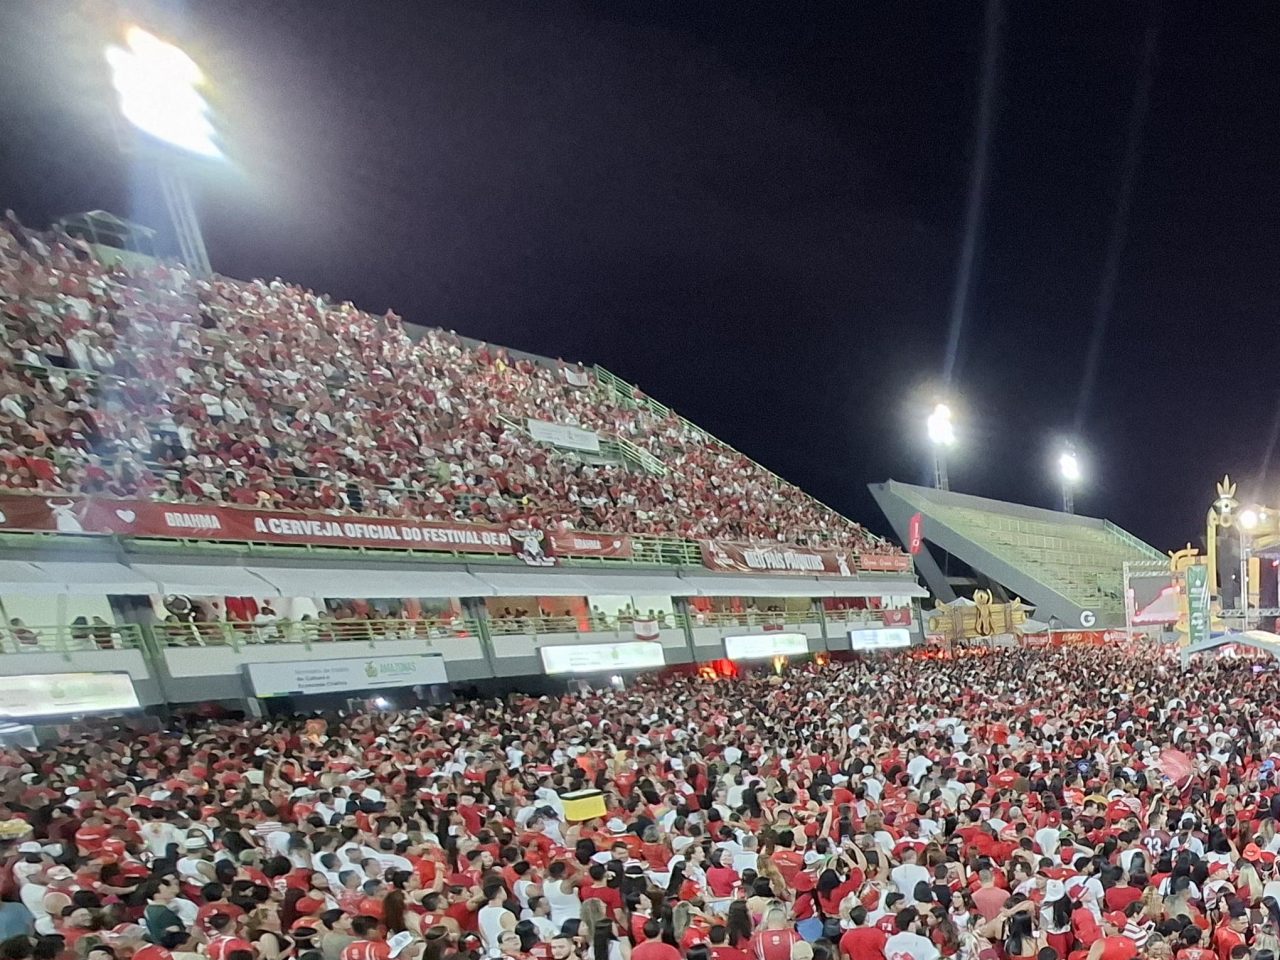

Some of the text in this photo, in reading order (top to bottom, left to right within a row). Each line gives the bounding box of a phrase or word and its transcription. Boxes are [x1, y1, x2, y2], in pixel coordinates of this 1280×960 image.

[164, 512, 221, 529] BRAHMA
[254, 517, 266, 533] A
[269, 518, 344, 537] CERVEJA
[345, 523, 400, 541] OFICIAL
[402, 527, 422, 541] DO
[424, 528, 479, 545] FESTIVAL
[480, 531, 499, 545] DE
[1080, 611, 1096, 627] G
[380, 661, 417, 674] AMAZONAS
